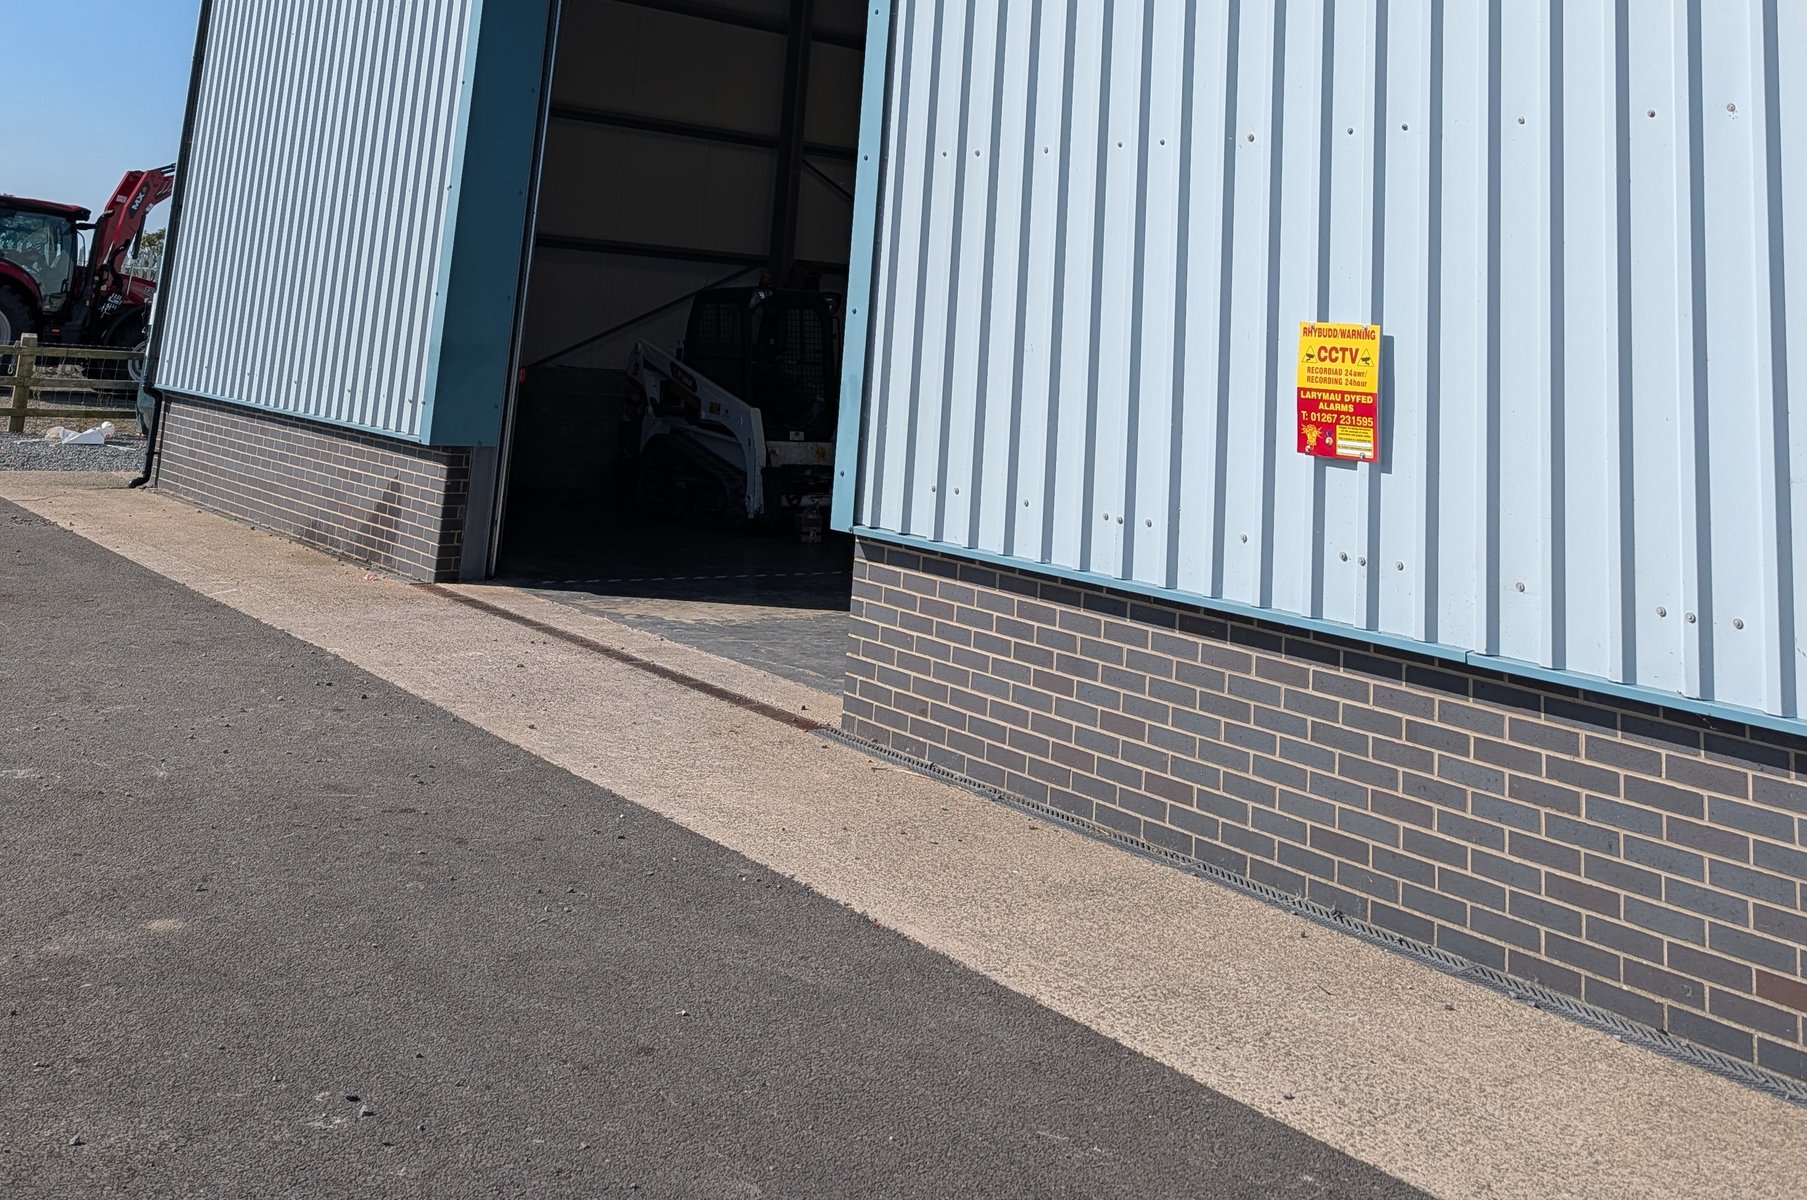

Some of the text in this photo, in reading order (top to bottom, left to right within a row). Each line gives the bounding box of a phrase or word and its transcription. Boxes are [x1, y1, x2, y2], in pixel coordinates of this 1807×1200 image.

[1318, 346, 1360, 365] CCTV
[1306, 366, 1343, 377] RECORDIAD
[1306, 375, 1368, 387] RECORDING 24hour
[1300, 390, 1373, 404] LARYMAU DYFED
[1318, 403, 1354, 413] ALARMS
[1310, 412, 1338, 424] 01267
[1340, 414, 1374, 427] 231595
